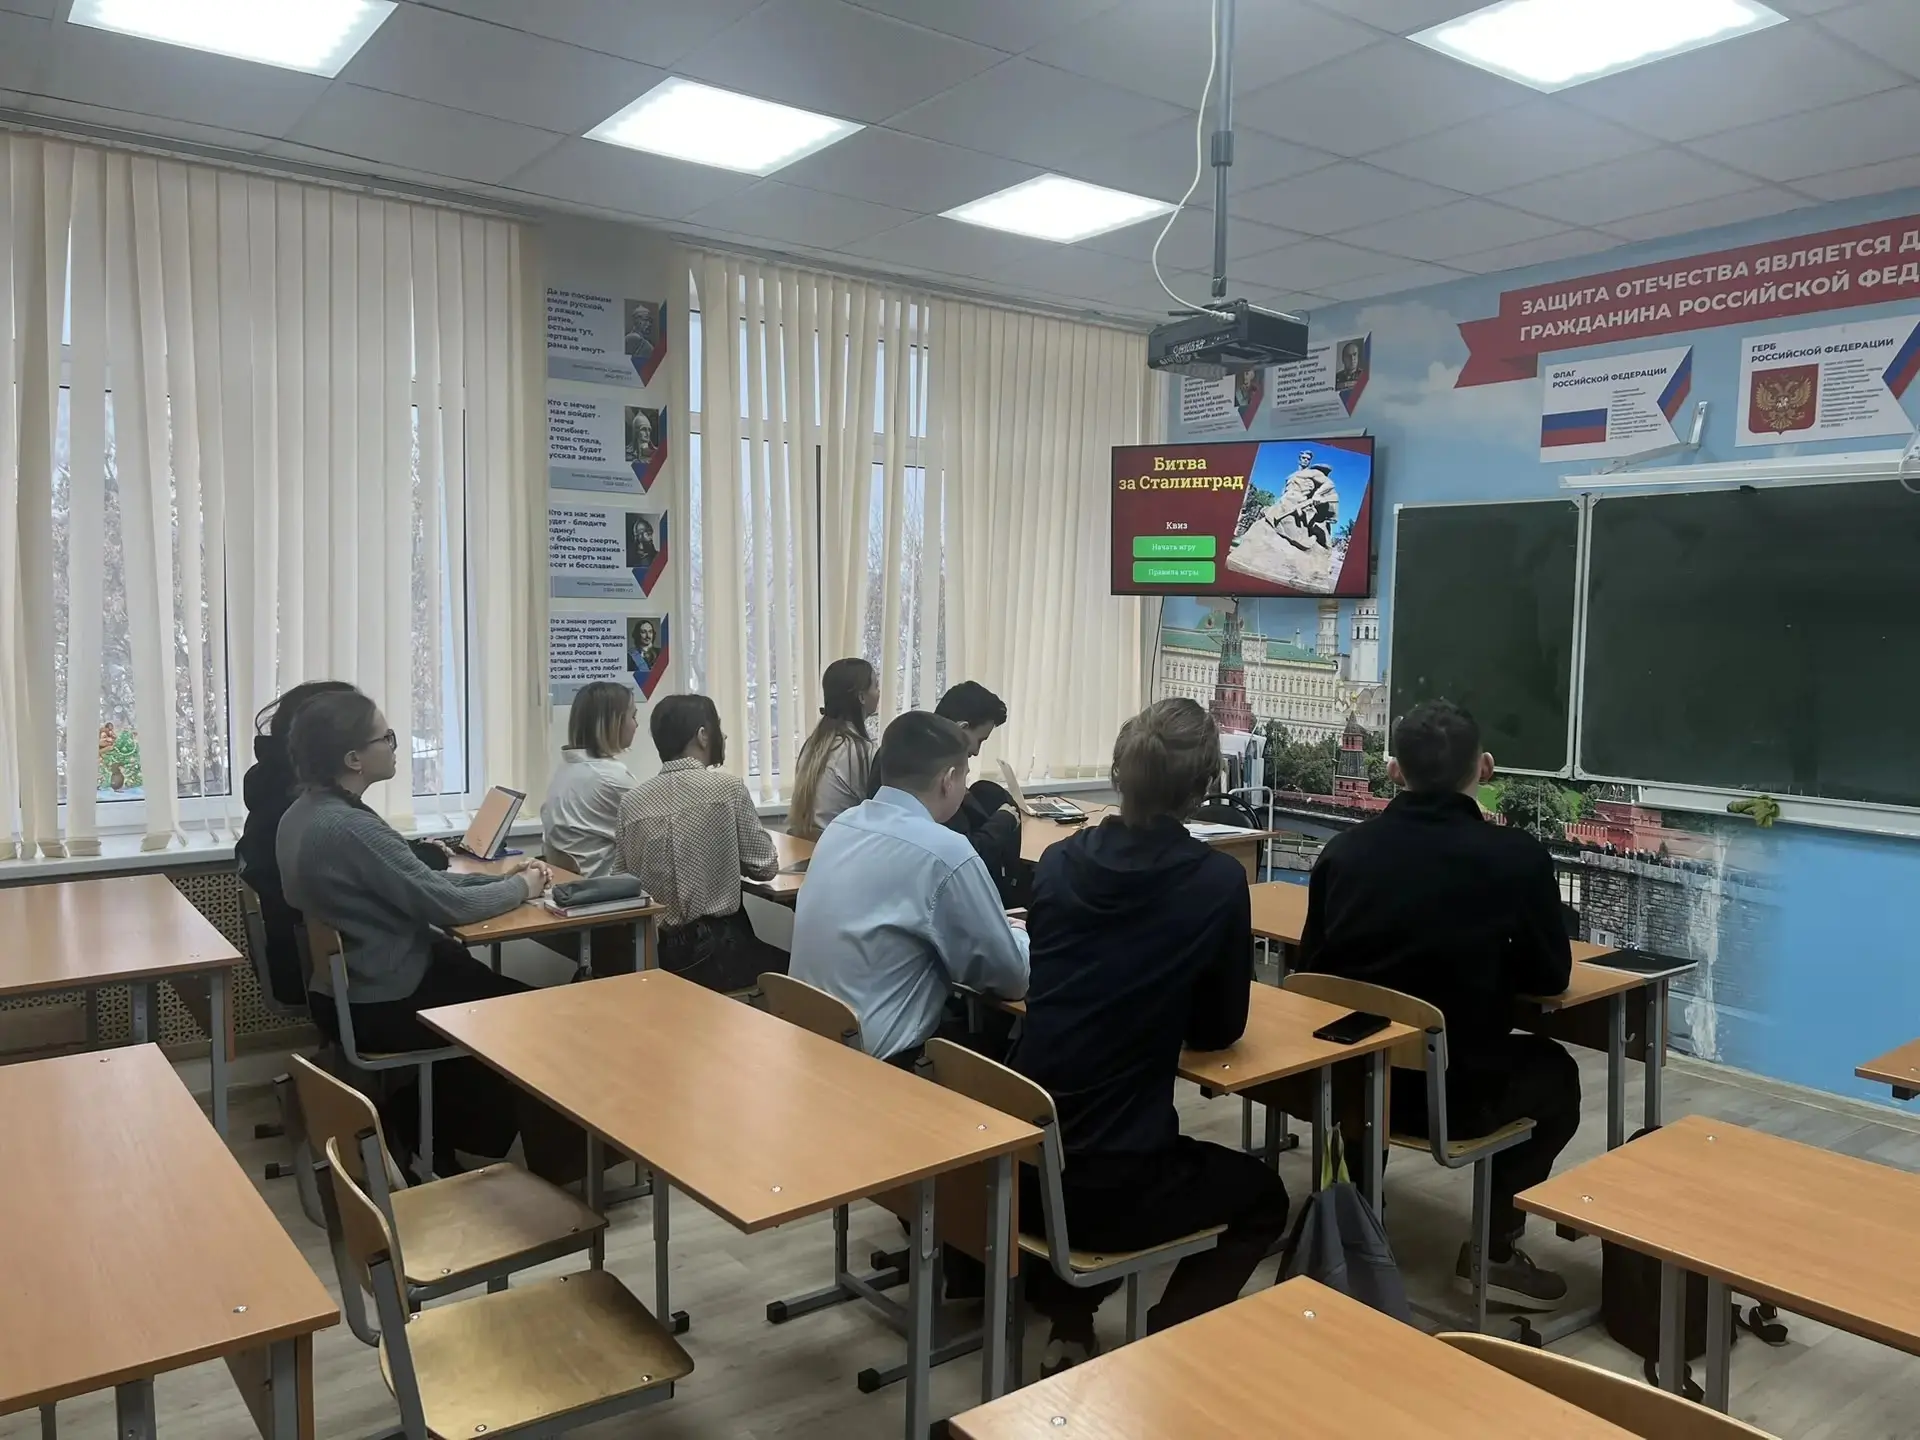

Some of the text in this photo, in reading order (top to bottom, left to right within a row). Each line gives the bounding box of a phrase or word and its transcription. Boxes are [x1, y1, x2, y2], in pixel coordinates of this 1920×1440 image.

[1521, 286, 1610, 316] ЗАЩИТА
[1615, 260, 1749, 298] ОТЕЧЕСТВА
[1754, 234, 1892, 275] ЯВЛЯЕТСЯ
[1519, 302, 1673, 342] ГРАЖДАНИНА
[1678, 269, 1850, 317] РОССИЙСКОЙ
[547, 315, 572, 324] ратие,
[547, 324, 576, 332] остьми
[547, 333, 578, 342] ертвые
[1751, 342, 1777, 353] ГЕРБ
[1751, 337, 1894, 363] РОССИЙСКОЙ ФЕДЕРАЦИИ
[1552, 369, 1577, 379] ФЛАГ
[1552, 367, 1667, 389] РОССИЙСКОЙ ФЕДЕРАЦИИ
[547, 398, 562, 406] Кто
[569, 401, 596, 409] мечом
[568, 410, 596, 419] войдет
[572, 436, 602, 445] стояла,
[550, 443, 602, 453] стоять будет
[549, 451, 576, 460] усская
[1153, 456, 1208, 472] Битва
[1118, 475, 1245, 492] за Сталинград
[548, 518, 566, 526] удет
[572, 518, 606, 527] блюдите
[1165, 521, 1189, 531] Квиз
[548, 527, 576, 535] одину!
[556, 535, 588, 543] бойтесь
[1151, 543, 1197, 553] Начать игру
[567, 553, 596, 561] смерть
[1148, 568, 1200, 578] Правила игры
